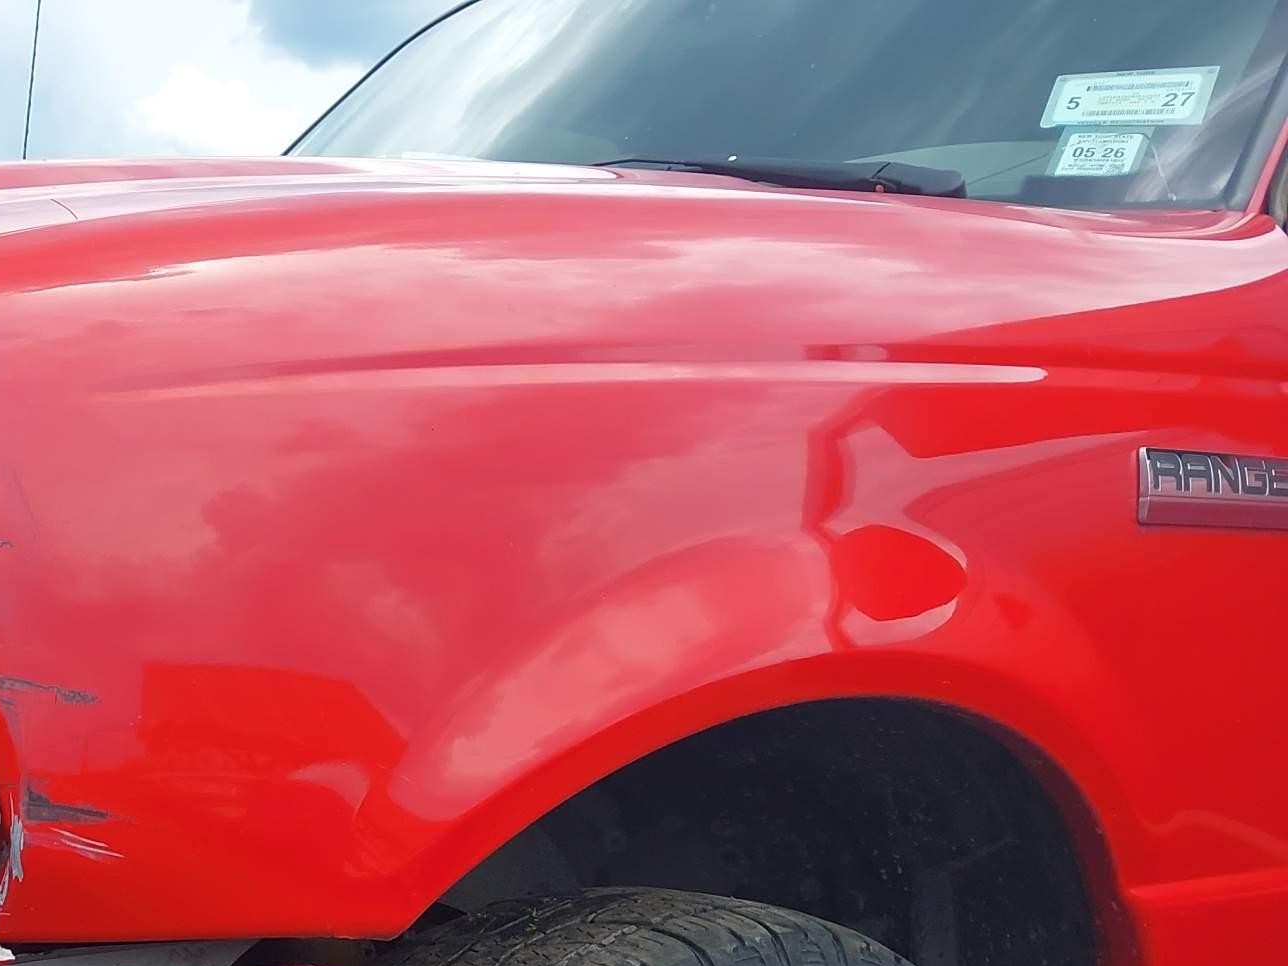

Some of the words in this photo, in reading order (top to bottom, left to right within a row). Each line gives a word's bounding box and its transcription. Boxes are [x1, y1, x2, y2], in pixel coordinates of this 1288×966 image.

[1066, 96, 1082, 110] 5
[1161, 92, 1196, 107] 27
[1072, 146, 1097, 158] 05
[1101, 147, 1127, 158] 26
